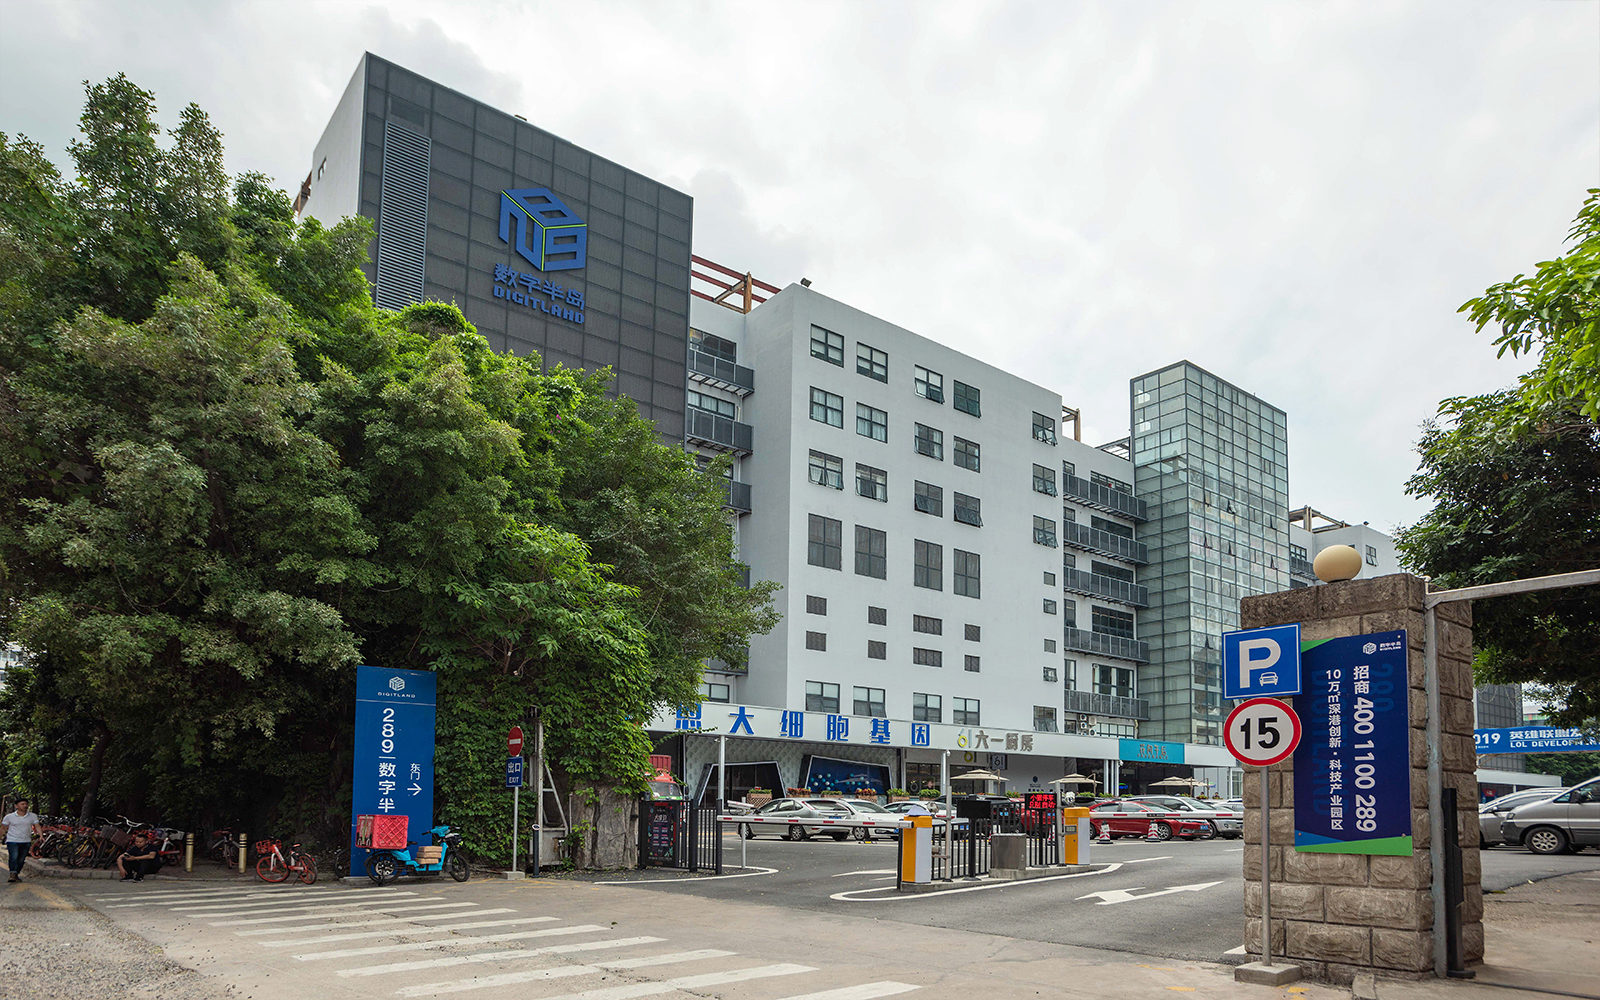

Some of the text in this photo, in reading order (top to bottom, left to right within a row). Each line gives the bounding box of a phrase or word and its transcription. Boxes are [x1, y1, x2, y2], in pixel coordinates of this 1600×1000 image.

[494, 262, 585, 311] 数字半岛
[1239, 638, 1281, 689] P
[377, 691, 416, 699] DIGITLAND
[381, 707, 395, 754] 289
[1240, 716, 1281, 750] 15
[1353, 664, 1377, 832] 招商 400 1100 289
[409, 762, 421, 781] 东门
[508, 762, 521, 773] 出口
